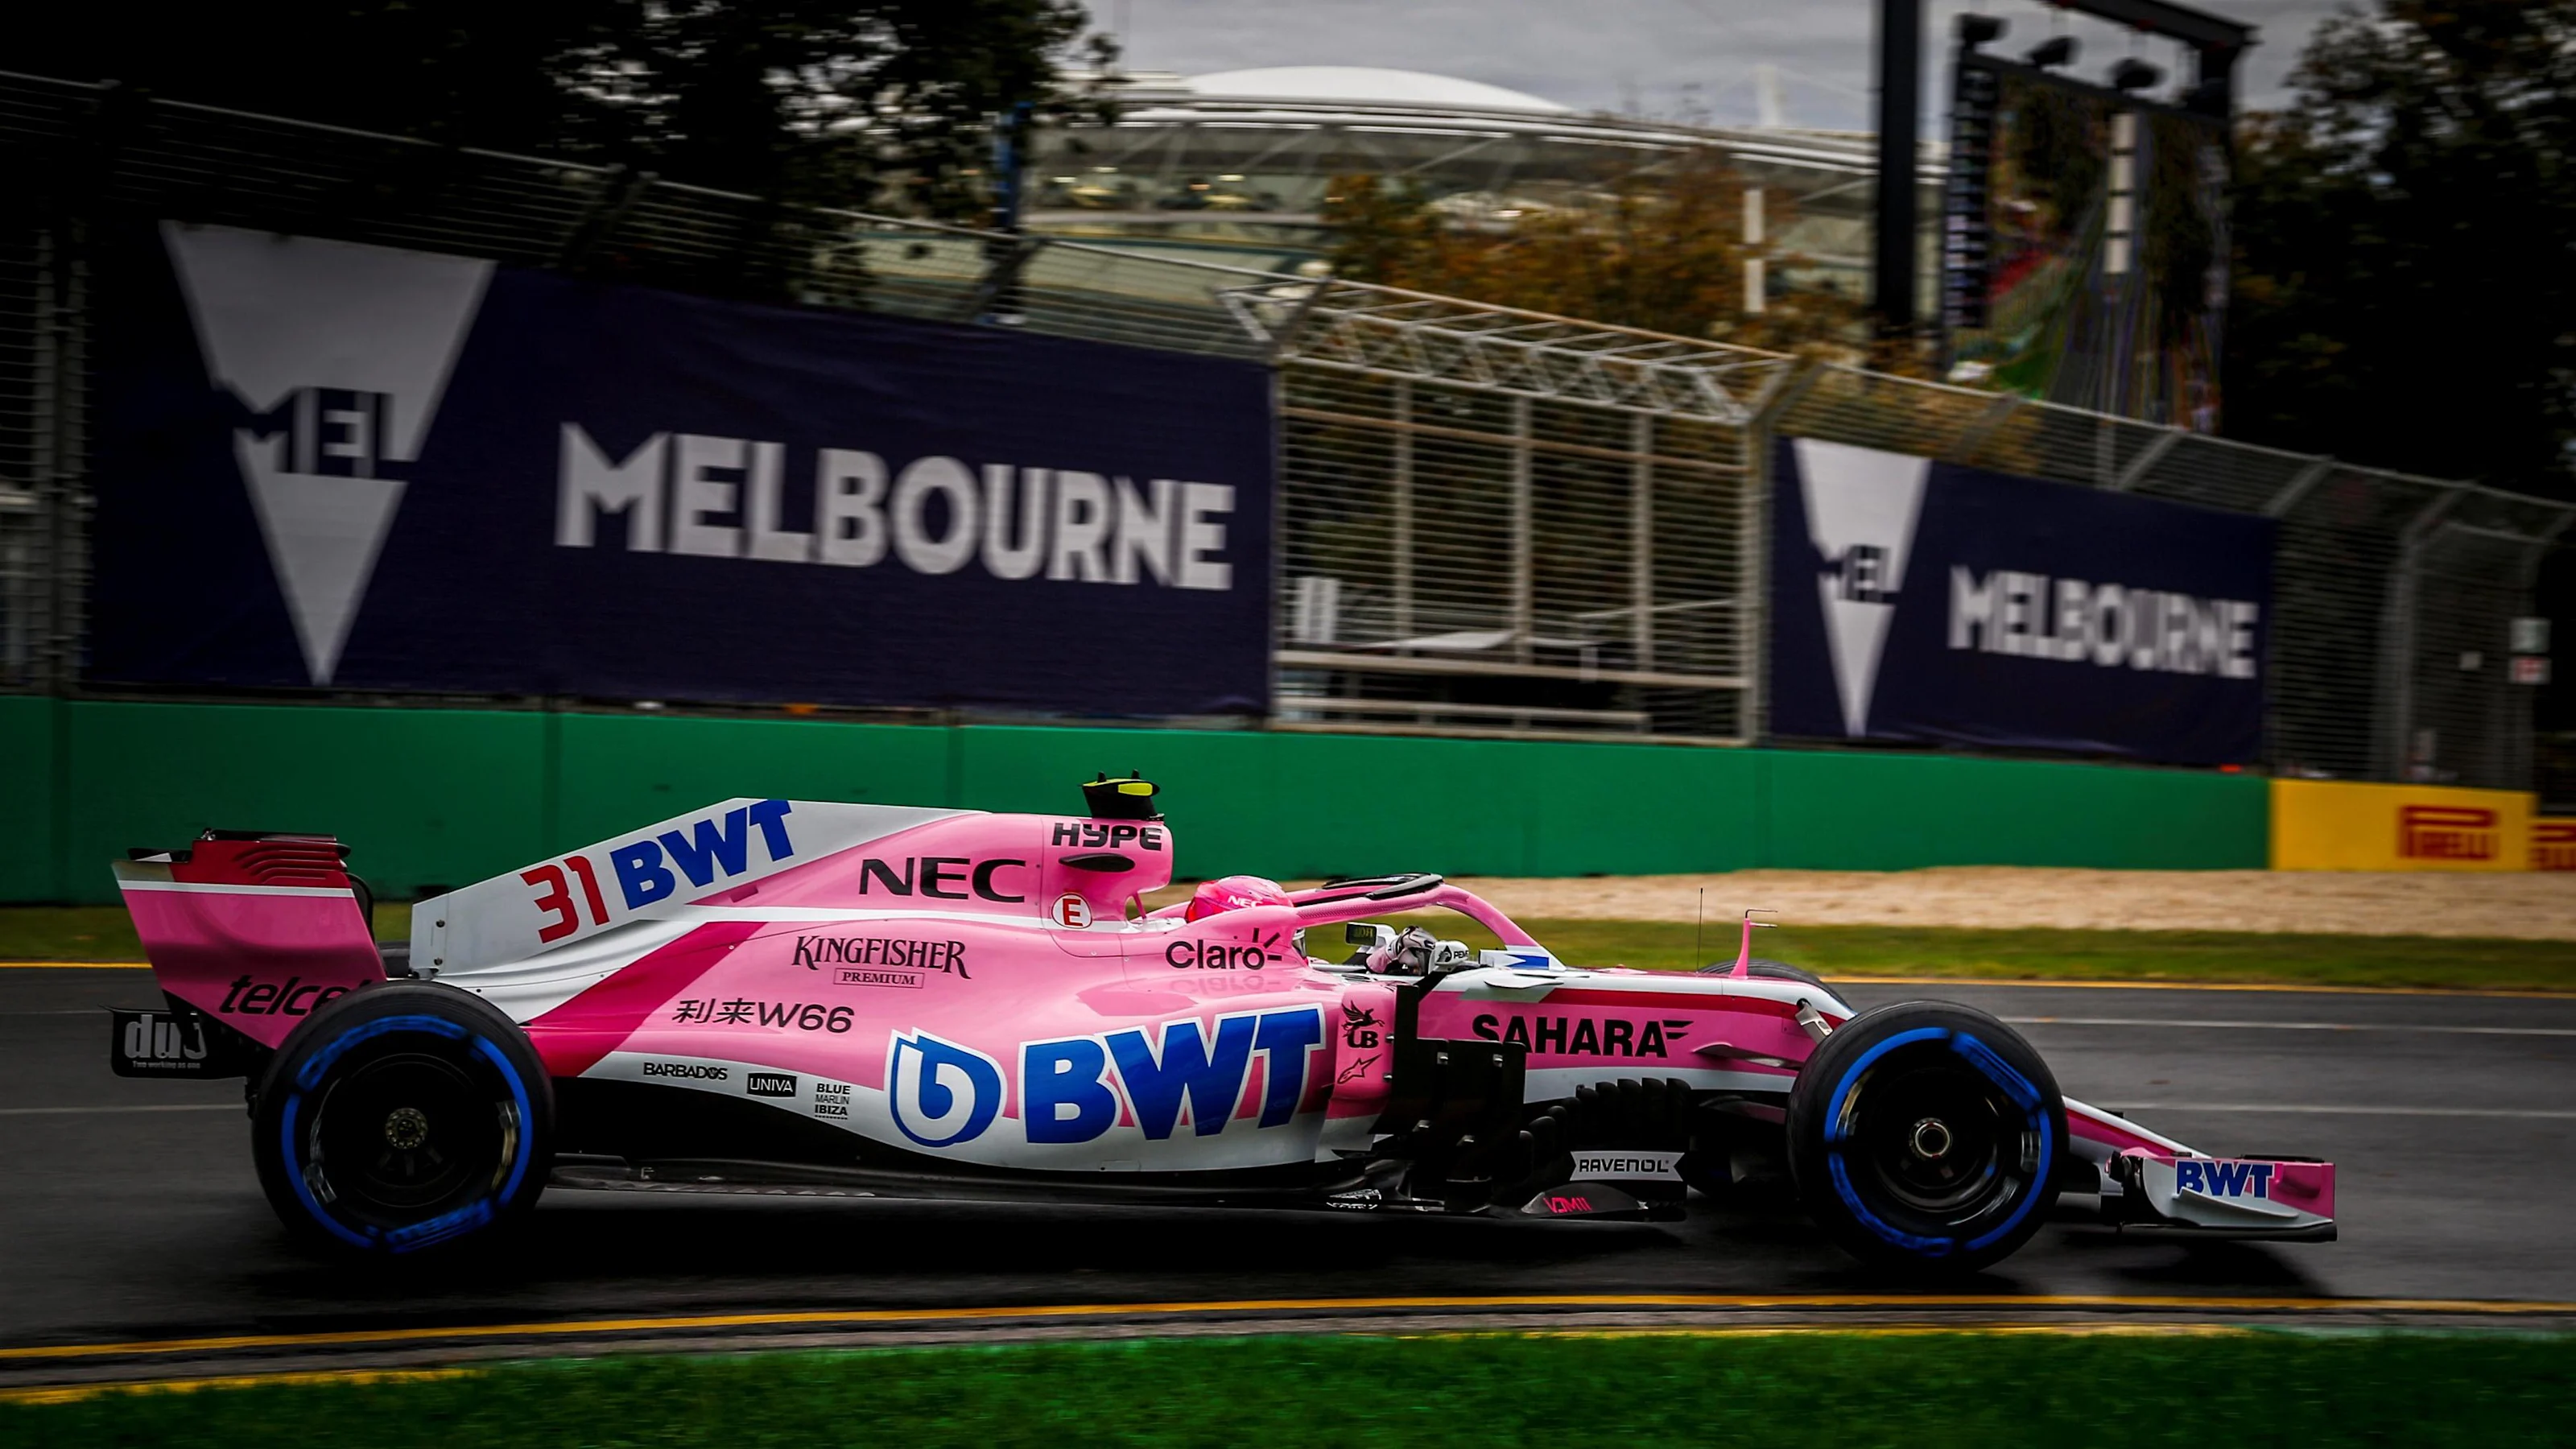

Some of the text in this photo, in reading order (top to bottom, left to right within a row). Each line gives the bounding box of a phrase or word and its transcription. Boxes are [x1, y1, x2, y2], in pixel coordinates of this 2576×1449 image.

[553, 420, 1236, 592] MELBOURNE
[1948, 564, 2260, 680] MELBOURNE
[1052, 823, 1162, 851] HYPE
[610, 799, 794, 910] BWT
[859, 857, 1026, 902] NEC
[520, 855, 609, 943] 31
[1063, 900, 1083, 927] E
[792, 935, 972, 979] KINGFISHER
[1166, 939, 1265, 970] Claro
[219, 975, 372, 1015] telce
[842, 972, 915, 985] PREMIUM
[1472, 1014, 1668, 1058] SAHARA
[644, 1063, 727, 1080] BARBADOS
[749, 1077, 794, 1092] UNIVA
[1025, 1009, 1321, 1144] BWT
[815, 1095, 849, 1104] MARLIN
[816, 1084, 850, 1095] BLUE
[815, 1104, 848, 1116] IBIZA
[1579, 1159, 1668, 1173] RAVENOL
[2177, 1162, 2273, 1198] BWT
